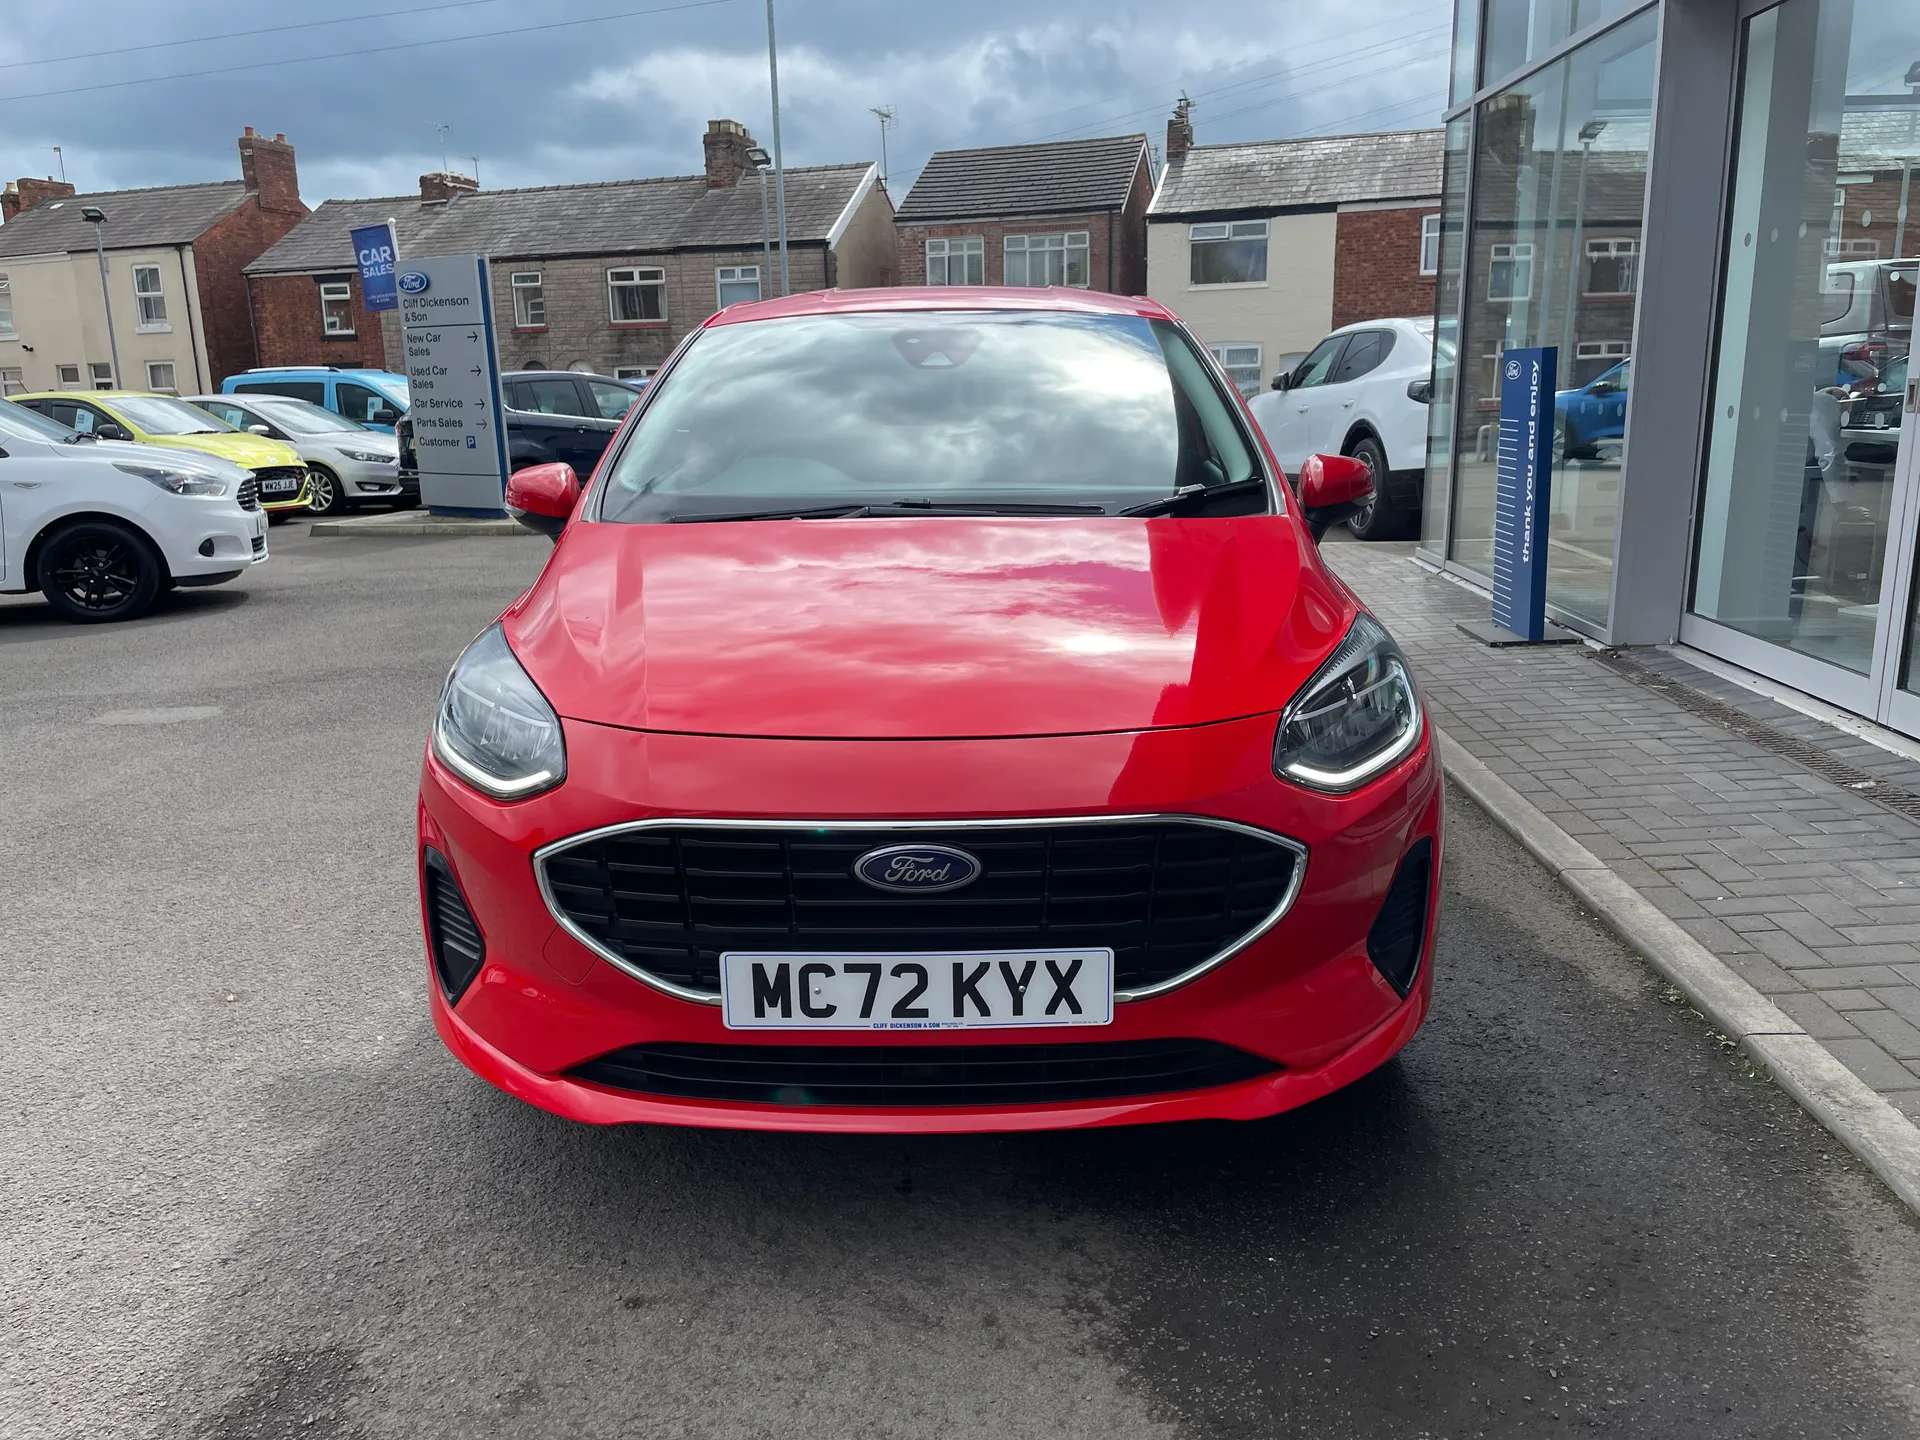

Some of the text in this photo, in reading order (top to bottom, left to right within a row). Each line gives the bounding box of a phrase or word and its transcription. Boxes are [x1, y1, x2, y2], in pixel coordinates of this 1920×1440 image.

[359, 245, 392, 266] CAR
[362, 263, 394, 279] SALES
[402, 275, 422, 290] Ford
[403, 297, 469, 309] Cliff Dickenson
[405, 312, 428, 322] & Son
[407, 332, 441, 343] New Car
[409, 347, 430, 357] Sales
[410, 366, 448, 376] Used Car
[412, 380, 434, 389] Sales
[415, 399, 463, 408] Car Service
[416, 418, 463, 428] Parts Sales
[420, 437, 460, 447] Customer
[1522, 360, 1539, 563] thank you and enjoy
[884, 856, 951, 881] Ford
[751, 959, 1083, 1019] MC72 KYX
